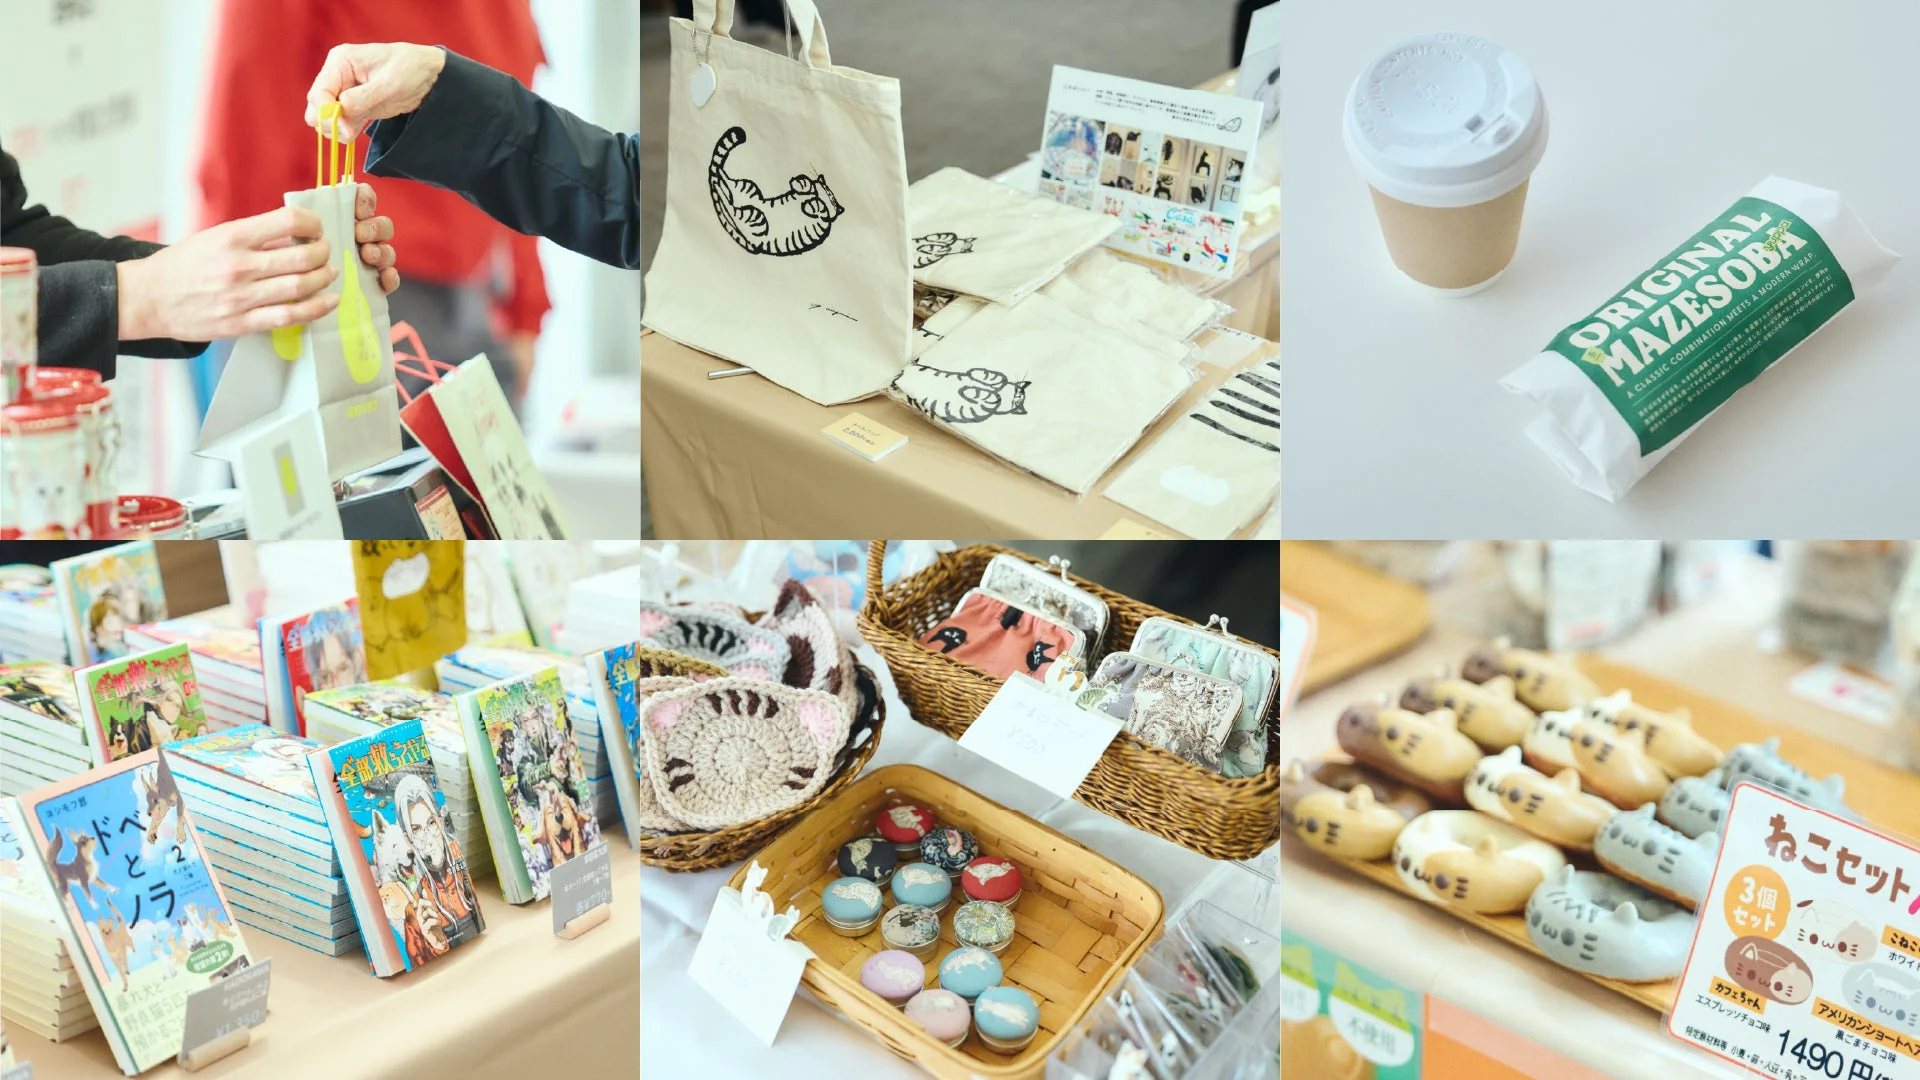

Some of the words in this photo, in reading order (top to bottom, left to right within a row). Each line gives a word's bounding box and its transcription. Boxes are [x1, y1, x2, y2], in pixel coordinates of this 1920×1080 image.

[1569, 212, 1772, 349] ORIGINAL
[1599, 226, 1808, 387] MAZESOBA
[1627, 390, 1636, 399] A
[1635, 362, 1670, 393] CLASSIC
[1670, 318, 1727, 365] COMBINATION
[1727, 299, 1751, 322] MEETS
[1752, 294, 1759, 302] A
[1759, 268, 1791, 297] MODERN
[340, 734, 431, 791] 全部救ってやる
[125, 853, 146, 879] と
[171, 845, 186, 863] 2
[1765, 813, 1911, 903] ねこセット
[1739, 876, 1778, 912] 3個
[1733, 905, 1776, 932] セット
[1890, 932, 1920, 953] こねこ
[1695, 994, 1772, 1033] エスプレッソチョコ味
[1715, 982, 1761, 1010] カフェちゃん
[1835, 1029, 1897, 1064] 黒ごまチョコ味
